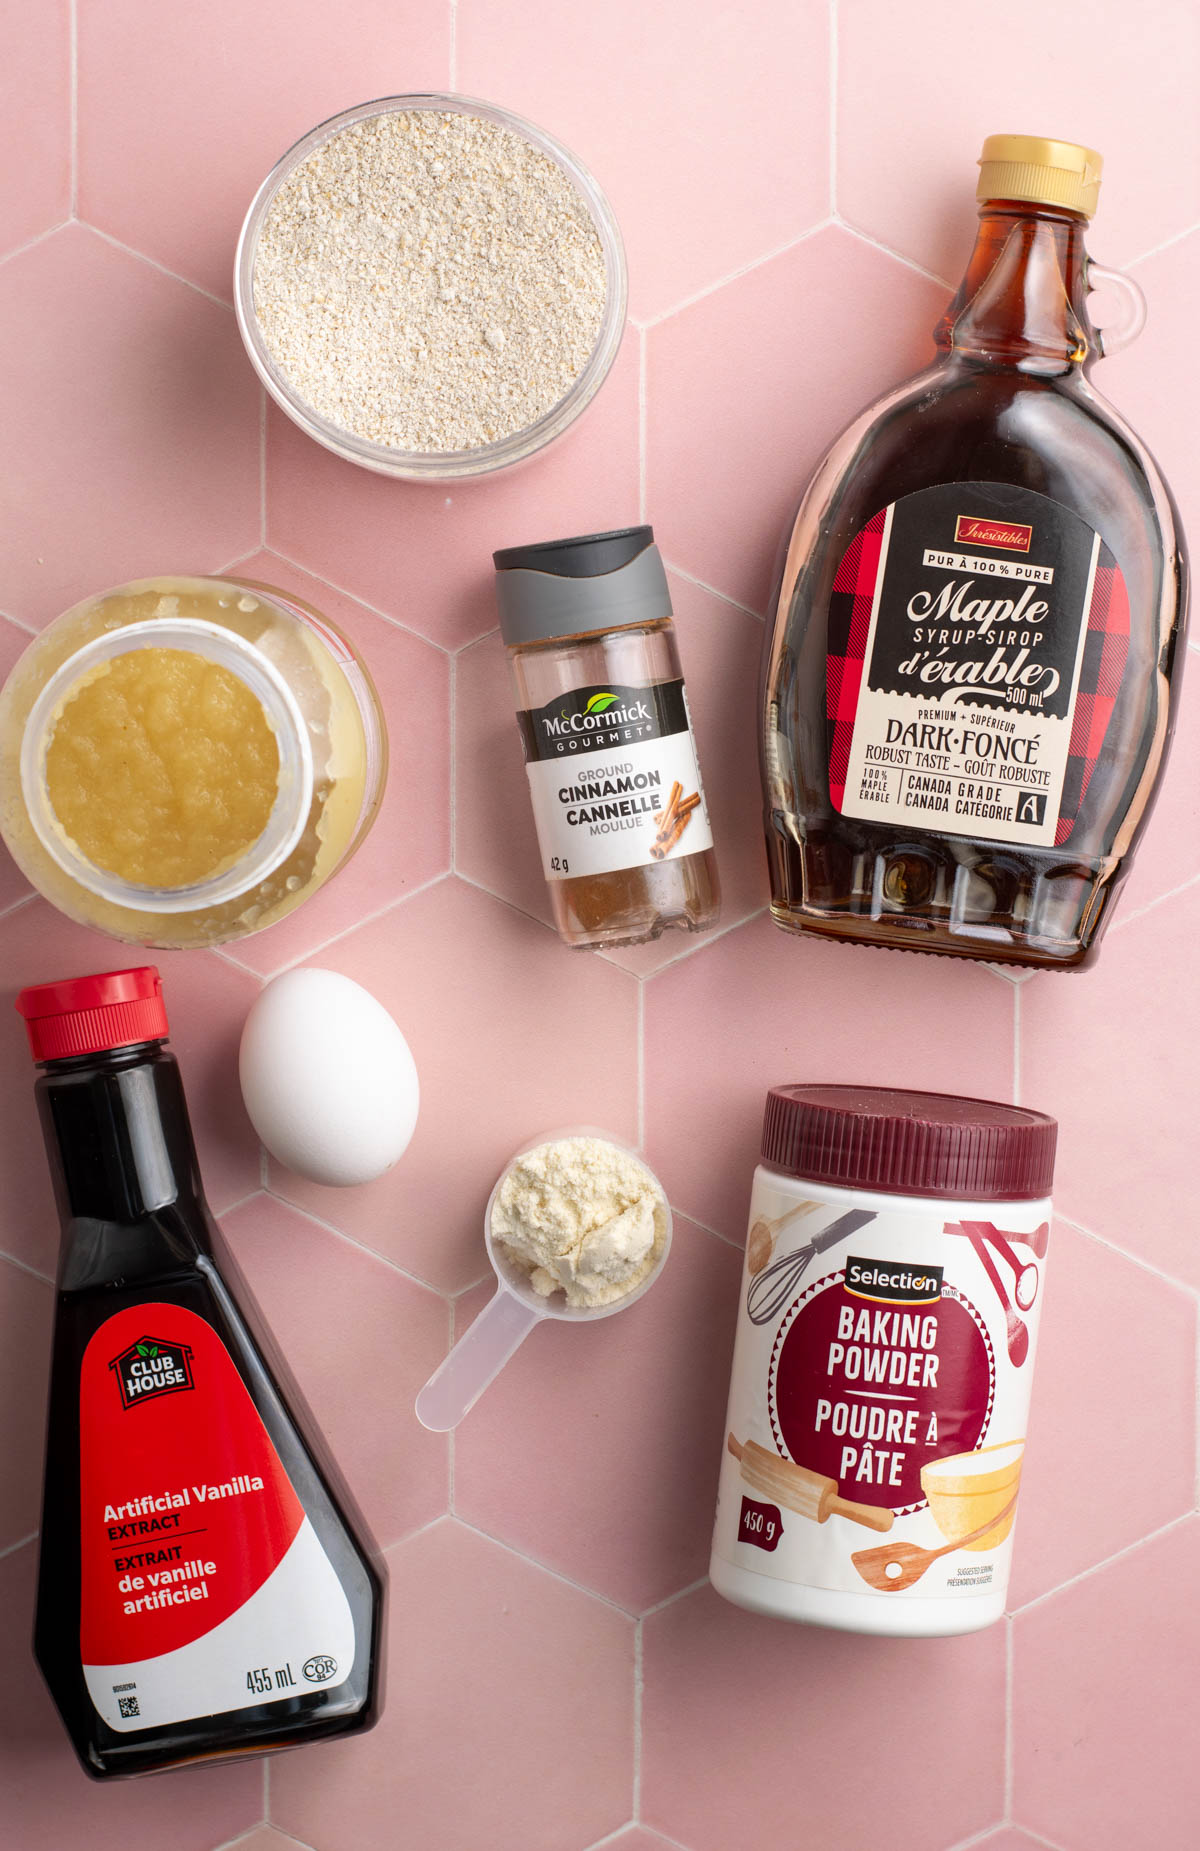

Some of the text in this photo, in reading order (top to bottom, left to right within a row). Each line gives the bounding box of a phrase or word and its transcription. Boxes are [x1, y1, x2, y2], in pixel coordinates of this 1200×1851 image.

[928, 555, 954, 566] PUR
[960, 556, 967, 568] À
[1015, 568, 1050, 580] PURE
[907, 580, 1049, 635] Maple
[1006, 686, 1044, 708] 500 mL
[542, 701, 652, 736] McCormick
[918, 709, 957, 721] PREMIUM
[970, 713, 1016, 734] SUPÉRIEUR
[557, 727, 645, 752] GOURMET
[578, 762, 633, 782] GROUND
[865, 744, 912, 764] ROBUST
[915, 752, 950, 770] TASTE
[964, 758, 996, 777] GOÛT
[999, 764, 1051, 786] ROBUSTE
[558, 770, 661, 803] CINNAMON
[861, 778, 887, 792] MAPLE
[908, 775, 1002, 803] CANADA GRADE
[566, 794, 662, 826] CANNELLE
[905, 792, 949, 812] CANADA
[955, 799, 1013, 822] CATÉGORIE
[590, 816, 643, 836] MOULUE
[551, 857, 569, 873] 42 g
[850, 1265, 937, 1292] Selection
[837, 1305, 938, 1350] BAKING
[130, 1355, 174, 1377] CLUB
[827, 1342, 939, 1388] POWDER
[126, 1368, 185, 1397] HOUSE
[815, 1399, 920, 1444] POUDRE
[839, 1442, 906, 1486] PÂTE
[104, 1475, 265, 1522] Artificial Vanilla
[107, 1514, 181, 1541] EXTRACT
[744, 1510, 776, 1541] 450 g
[113, 1546, 182, 1572] EXTRAIT
[118, 1559, 217, 1593] de vanille
[124, 1581, 209, 1615] artificiel
[246, 1663, 297, 1694] 455 mL
[304, 1660, 337, 1678] COR
